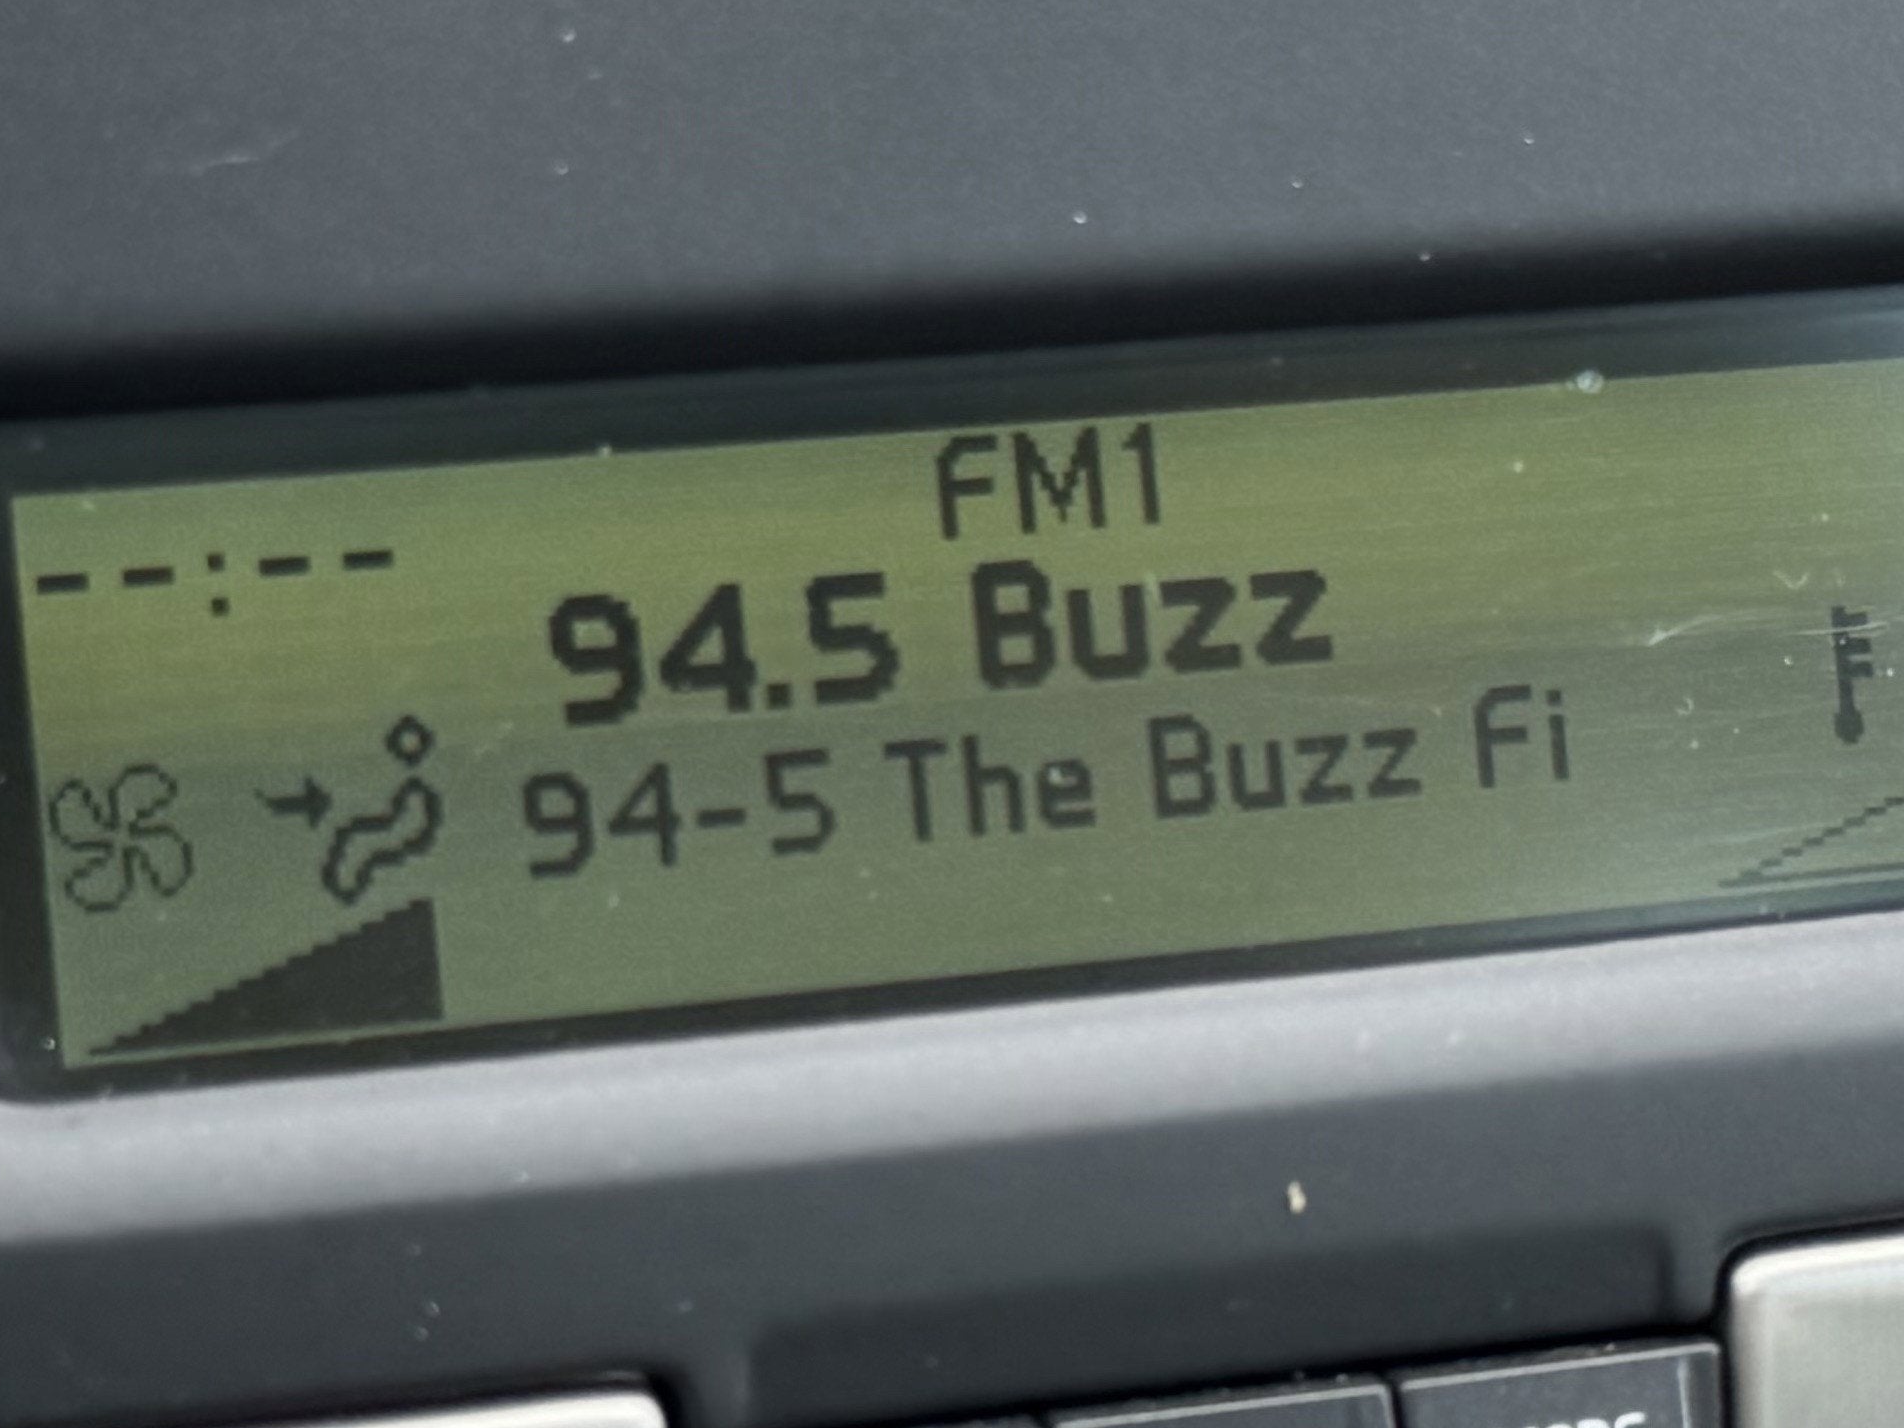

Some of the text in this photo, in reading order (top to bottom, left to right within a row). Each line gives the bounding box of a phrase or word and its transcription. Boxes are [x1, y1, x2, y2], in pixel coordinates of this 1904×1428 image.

[935, 422, 1161, 541] FM1
[548, 559, 1334, 728] 94.5 Buzz
[522, 684, 1569, 881] 94-5 The Buzz Fi
